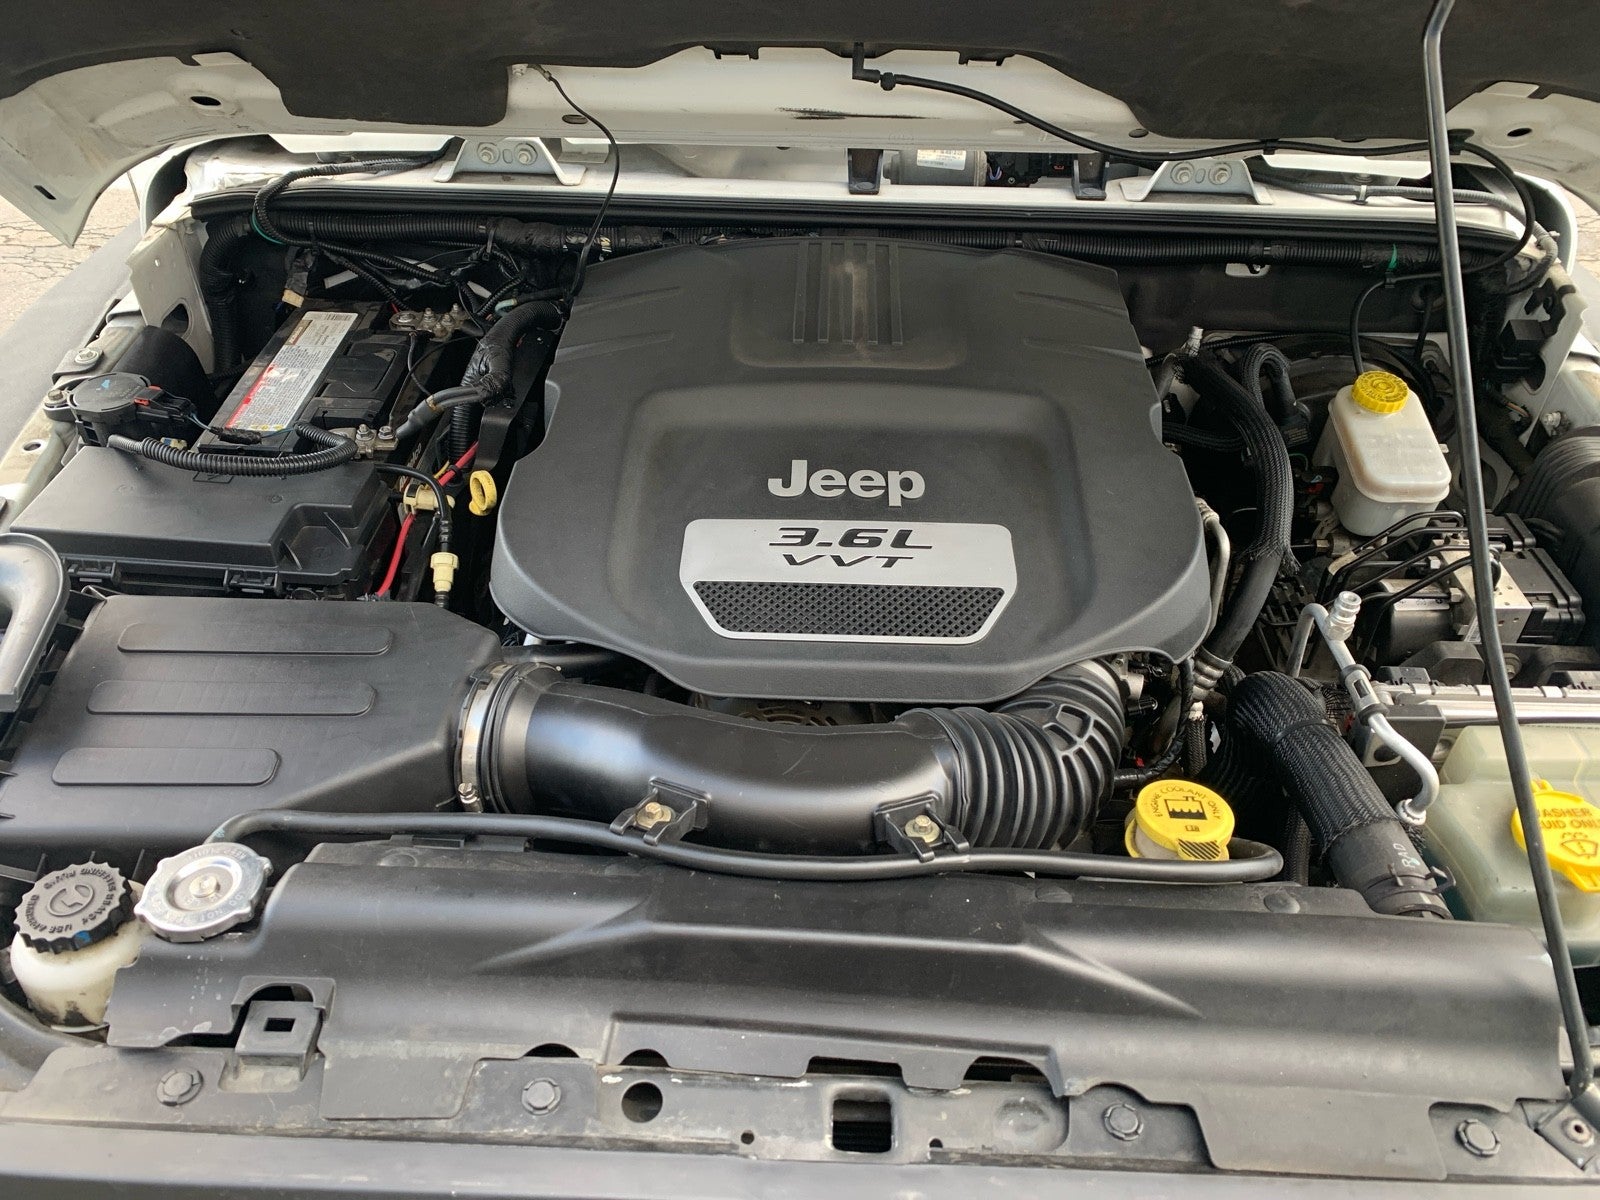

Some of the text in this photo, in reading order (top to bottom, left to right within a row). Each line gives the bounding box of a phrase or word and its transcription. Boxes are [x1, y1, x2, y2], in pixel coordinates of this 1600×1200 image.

[768, 460, 926, 507] Jeep
[769, 528, 932, 549] 3.6L
[782, 554, 914, 568] VVT
[1150, 786, 1222, 820] ENGINE COOLANT ONLY
[1538, 808, 1592, 818] ASHER
